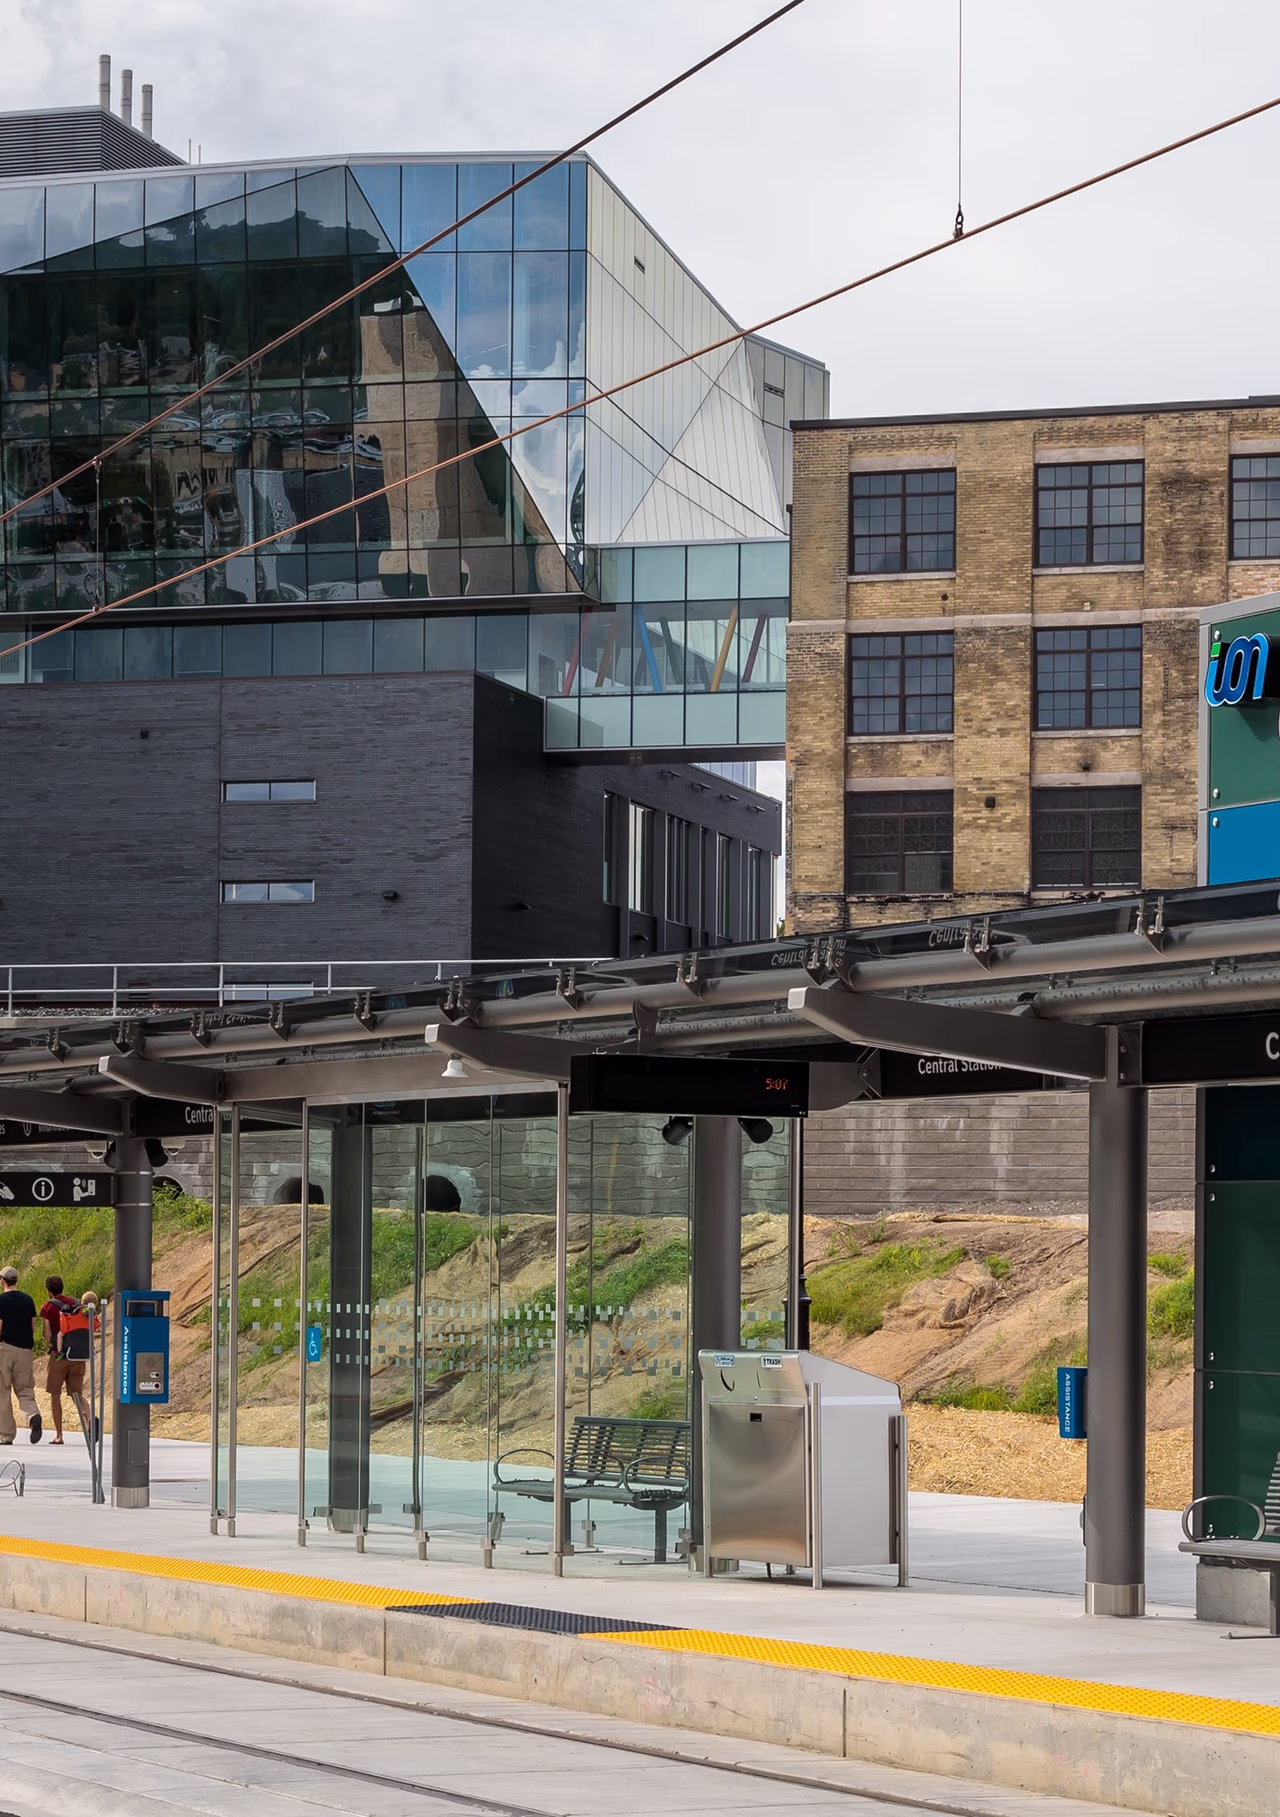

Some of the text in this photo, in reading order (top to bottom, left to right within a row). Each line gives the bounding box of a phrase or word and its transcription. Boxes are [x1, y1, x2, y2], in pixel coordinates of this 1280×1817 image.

[918, 1058, 959, 1075] Central
[765, 1078, 789, 1090] 5:07
[185, 1106, 214, 1124] Centra
